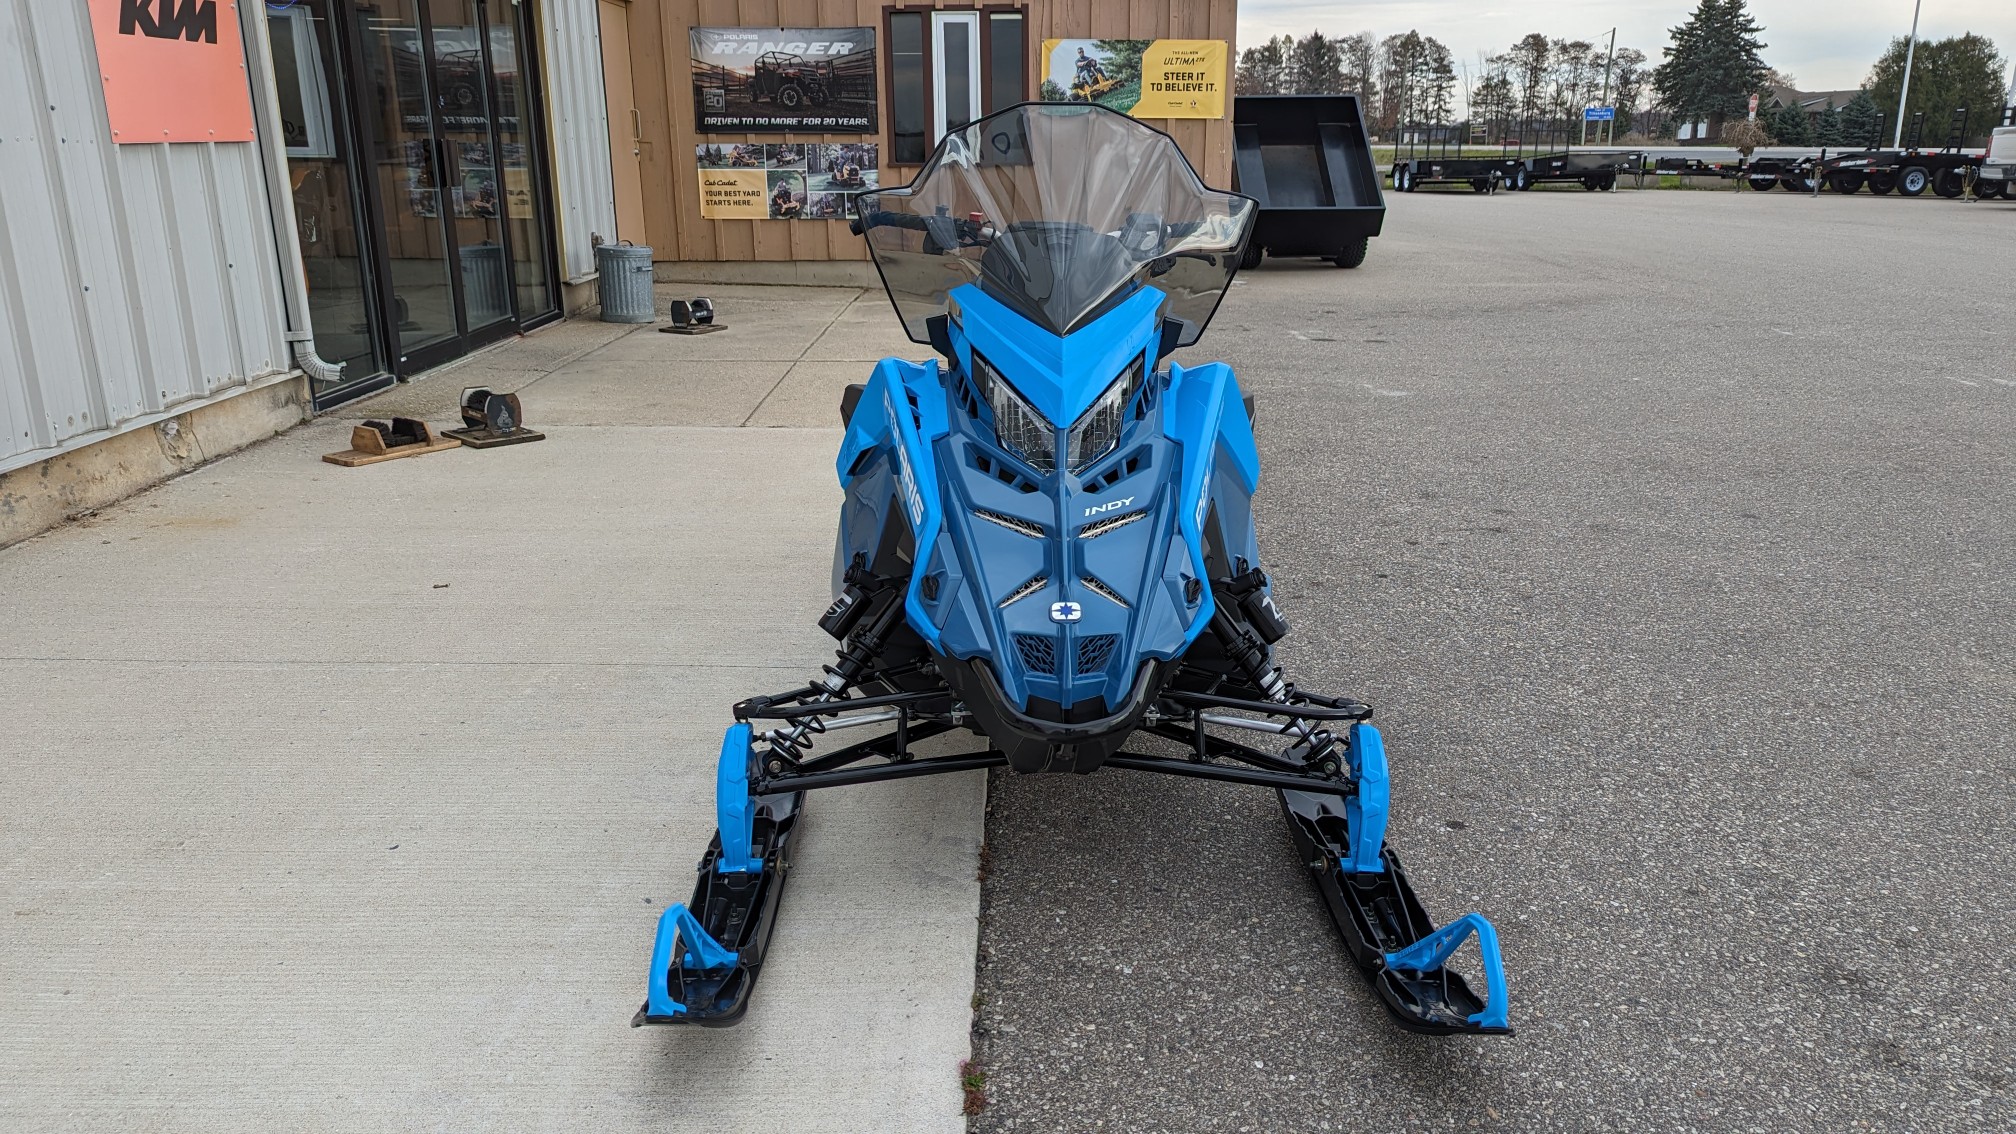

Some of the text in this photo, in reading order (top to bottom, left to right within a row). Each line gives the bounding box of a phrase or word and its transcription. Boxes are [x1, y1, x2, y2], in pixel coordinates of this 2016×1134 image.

[119, 0, 217, 44] KTM
[711, 41, 855, 55] RANGER
[1163, 57, 1195, 66] ULTIMA
[1163, 72, 1205, 81] STEER IT
[1150, 83, 1217, 92] TO BELIEVE IT.
[705, 94, 722, 107] 20
[704, 117, 740, 125] DRIVEN
[741, 117, 753, 125] TO
[755, 117, 768, 125] DO
[803, 117, 821, 125] FOR
[823, 117, 836, 125] 20
[837, 117, 870, 125] YEARS.
[1084, 496, 1135, 517] INDY
